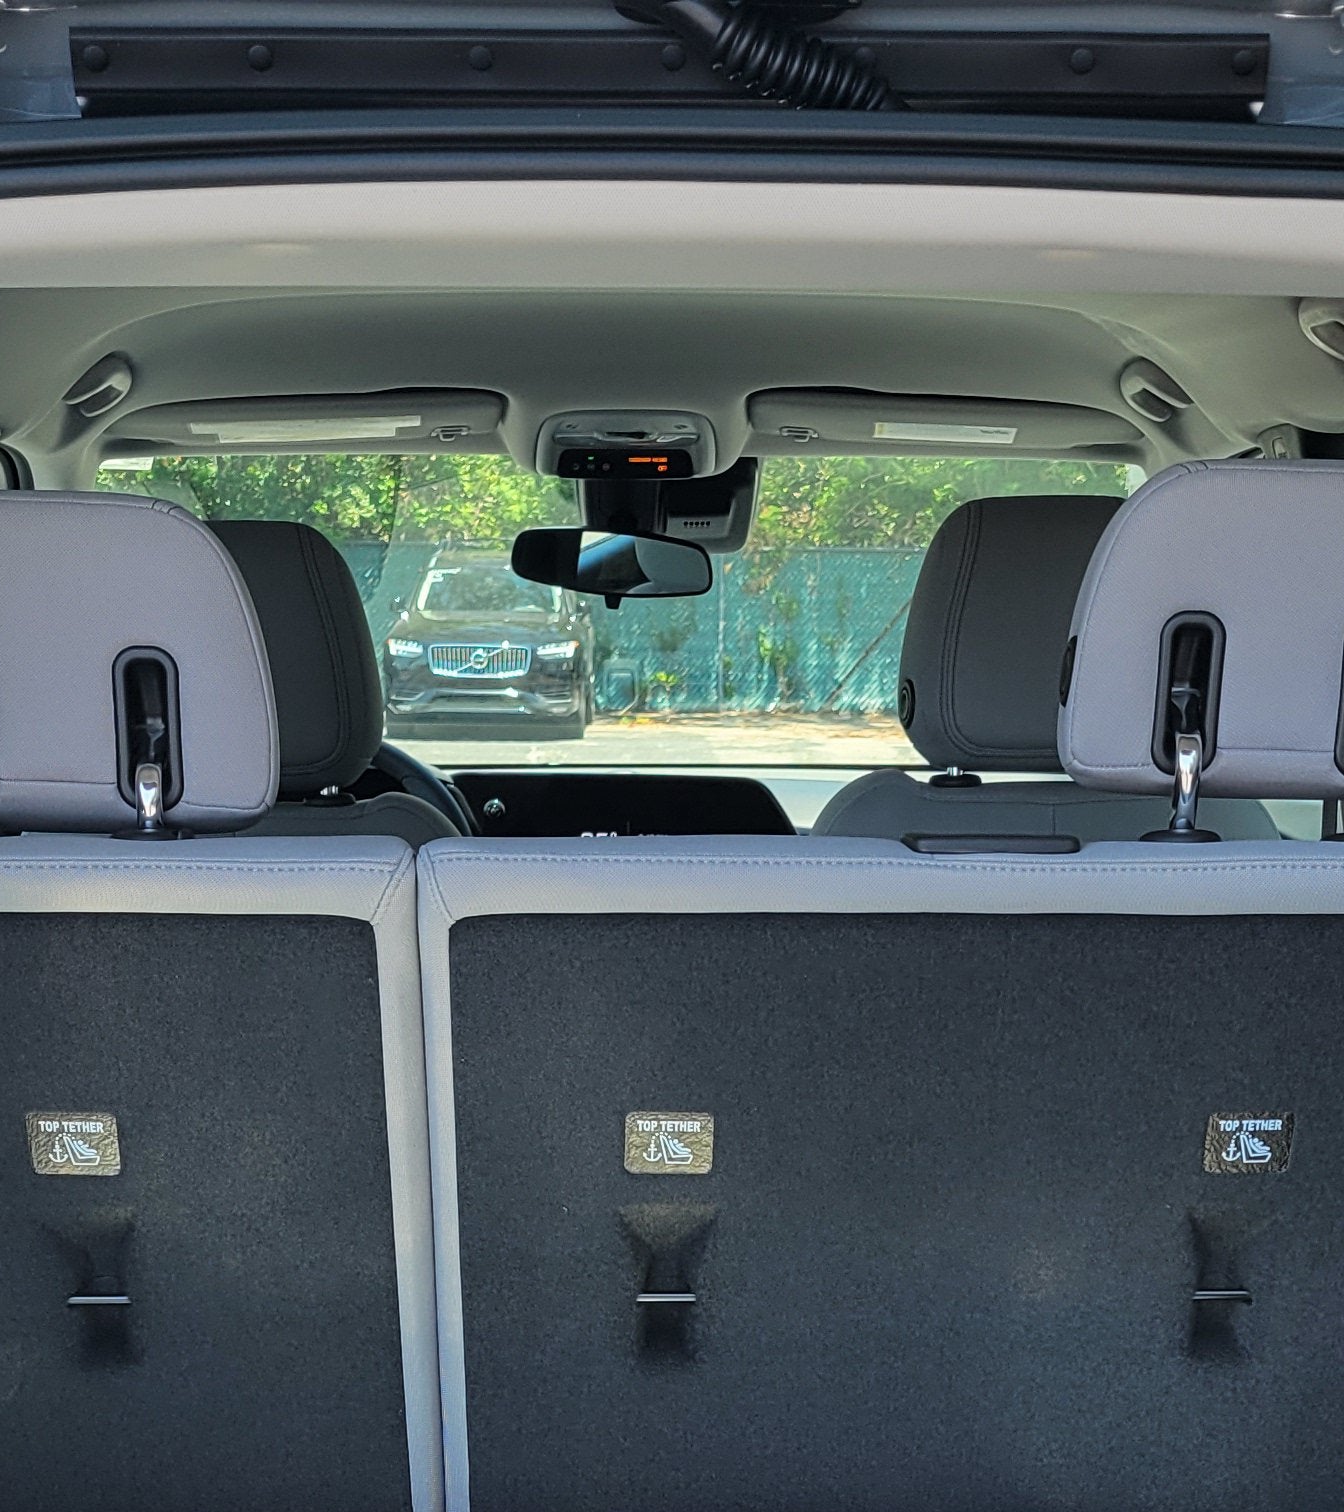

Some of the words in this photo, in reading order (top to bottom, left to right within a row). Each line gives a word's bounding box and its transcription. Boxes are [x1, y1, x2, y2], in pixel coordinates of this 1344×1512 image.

[37, 1120, 60, 1133] TOP
[61, 1120, 105, 1134] TETHER
[636, 1119, 657, 1132] TOP
[659, 1119, 701, 1133] TETHER
[1218, 1119, 1240, 1132] TOP
[1241, 1119, 1283, 1132] TETHER
